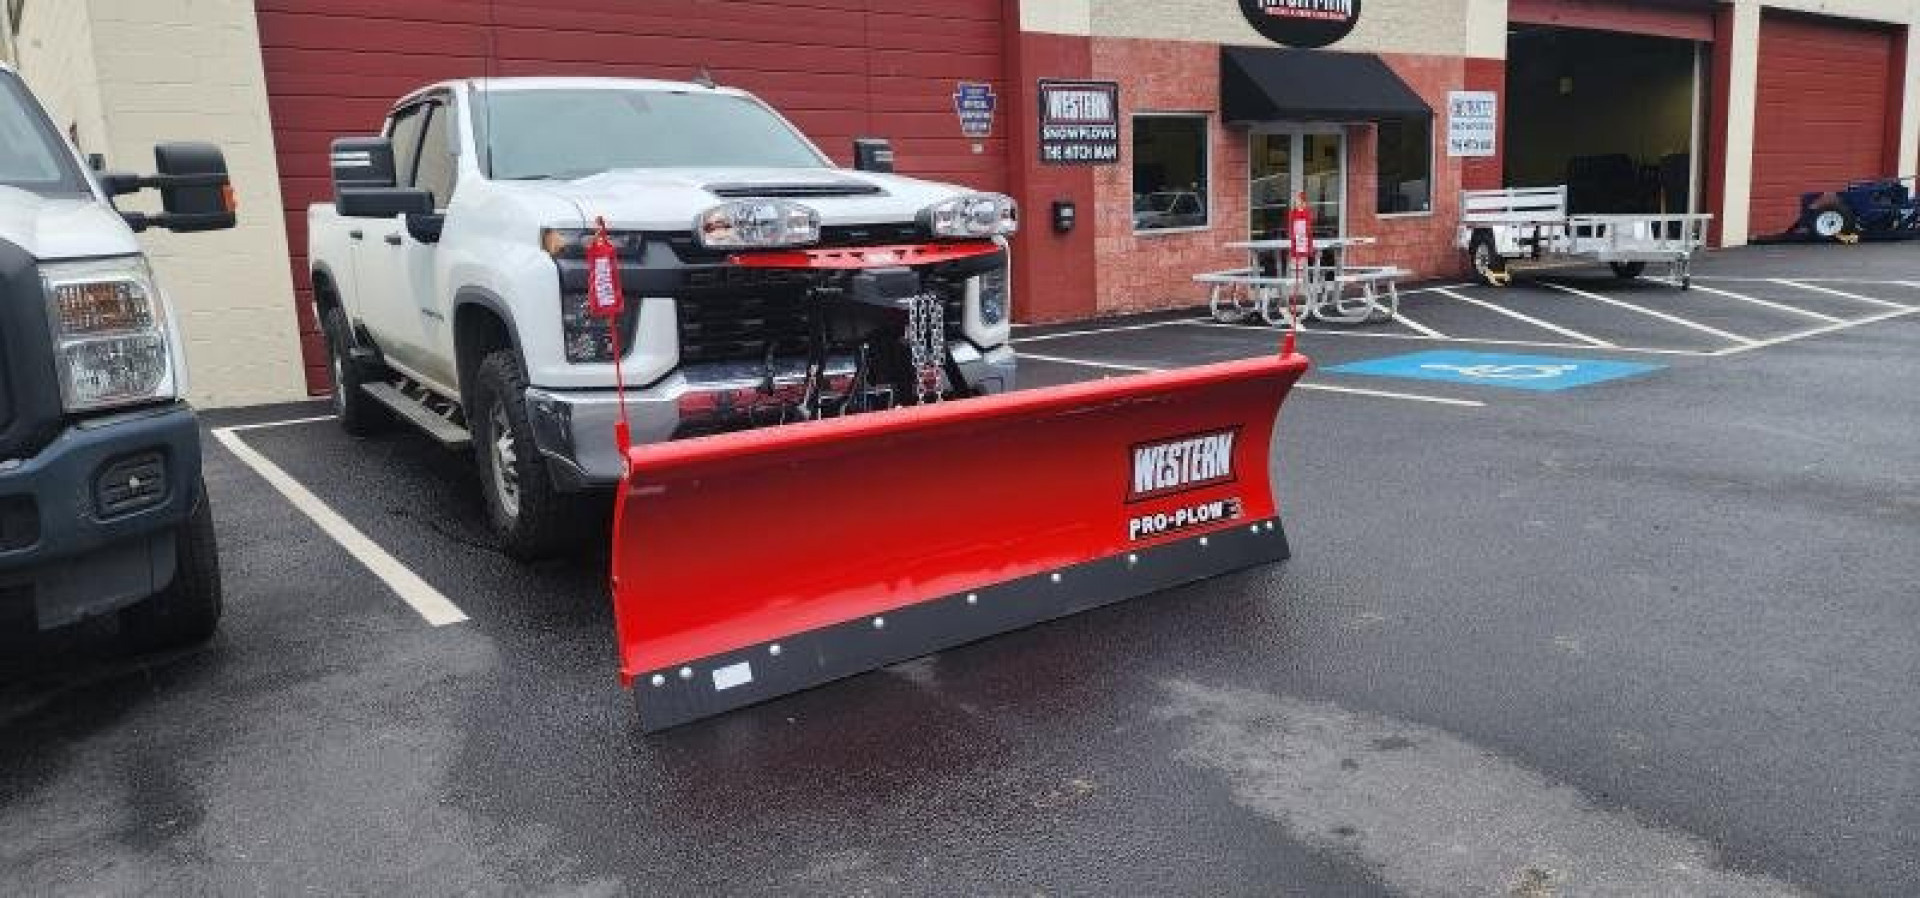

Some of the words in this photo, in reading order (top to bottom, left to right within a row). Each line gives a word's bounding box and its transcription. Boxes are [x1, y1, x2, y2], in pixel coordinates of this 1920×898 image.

[1048, 90, 1111, 119] WESTERN
[1043, 144, 1062, 159] THE
[1133, 431, 1234, 493] WESTERN
